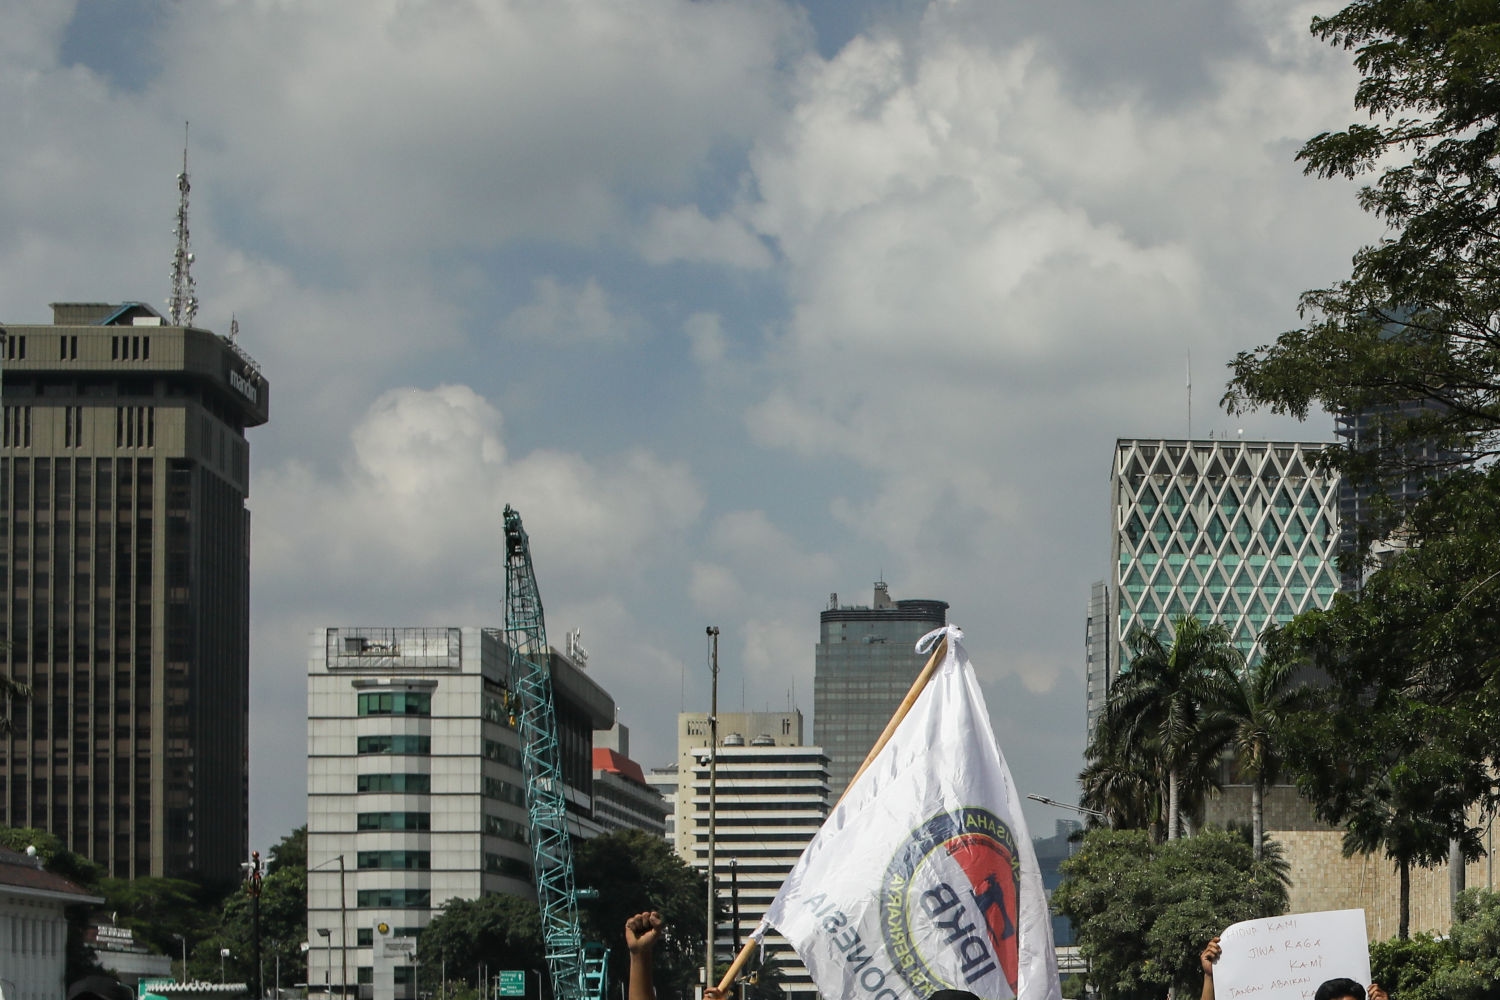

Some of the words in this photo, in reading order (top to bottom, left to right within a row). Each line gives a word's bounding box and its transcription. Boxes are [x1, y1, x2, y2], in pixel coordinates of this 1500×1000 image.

[1267, 920, 1297, 933] KAMI
[1248, 945, 1275, 960] JIWA
[1285, 937, 1321, 951] RAGA
[1289, 955, 1323, 972] KAMI
